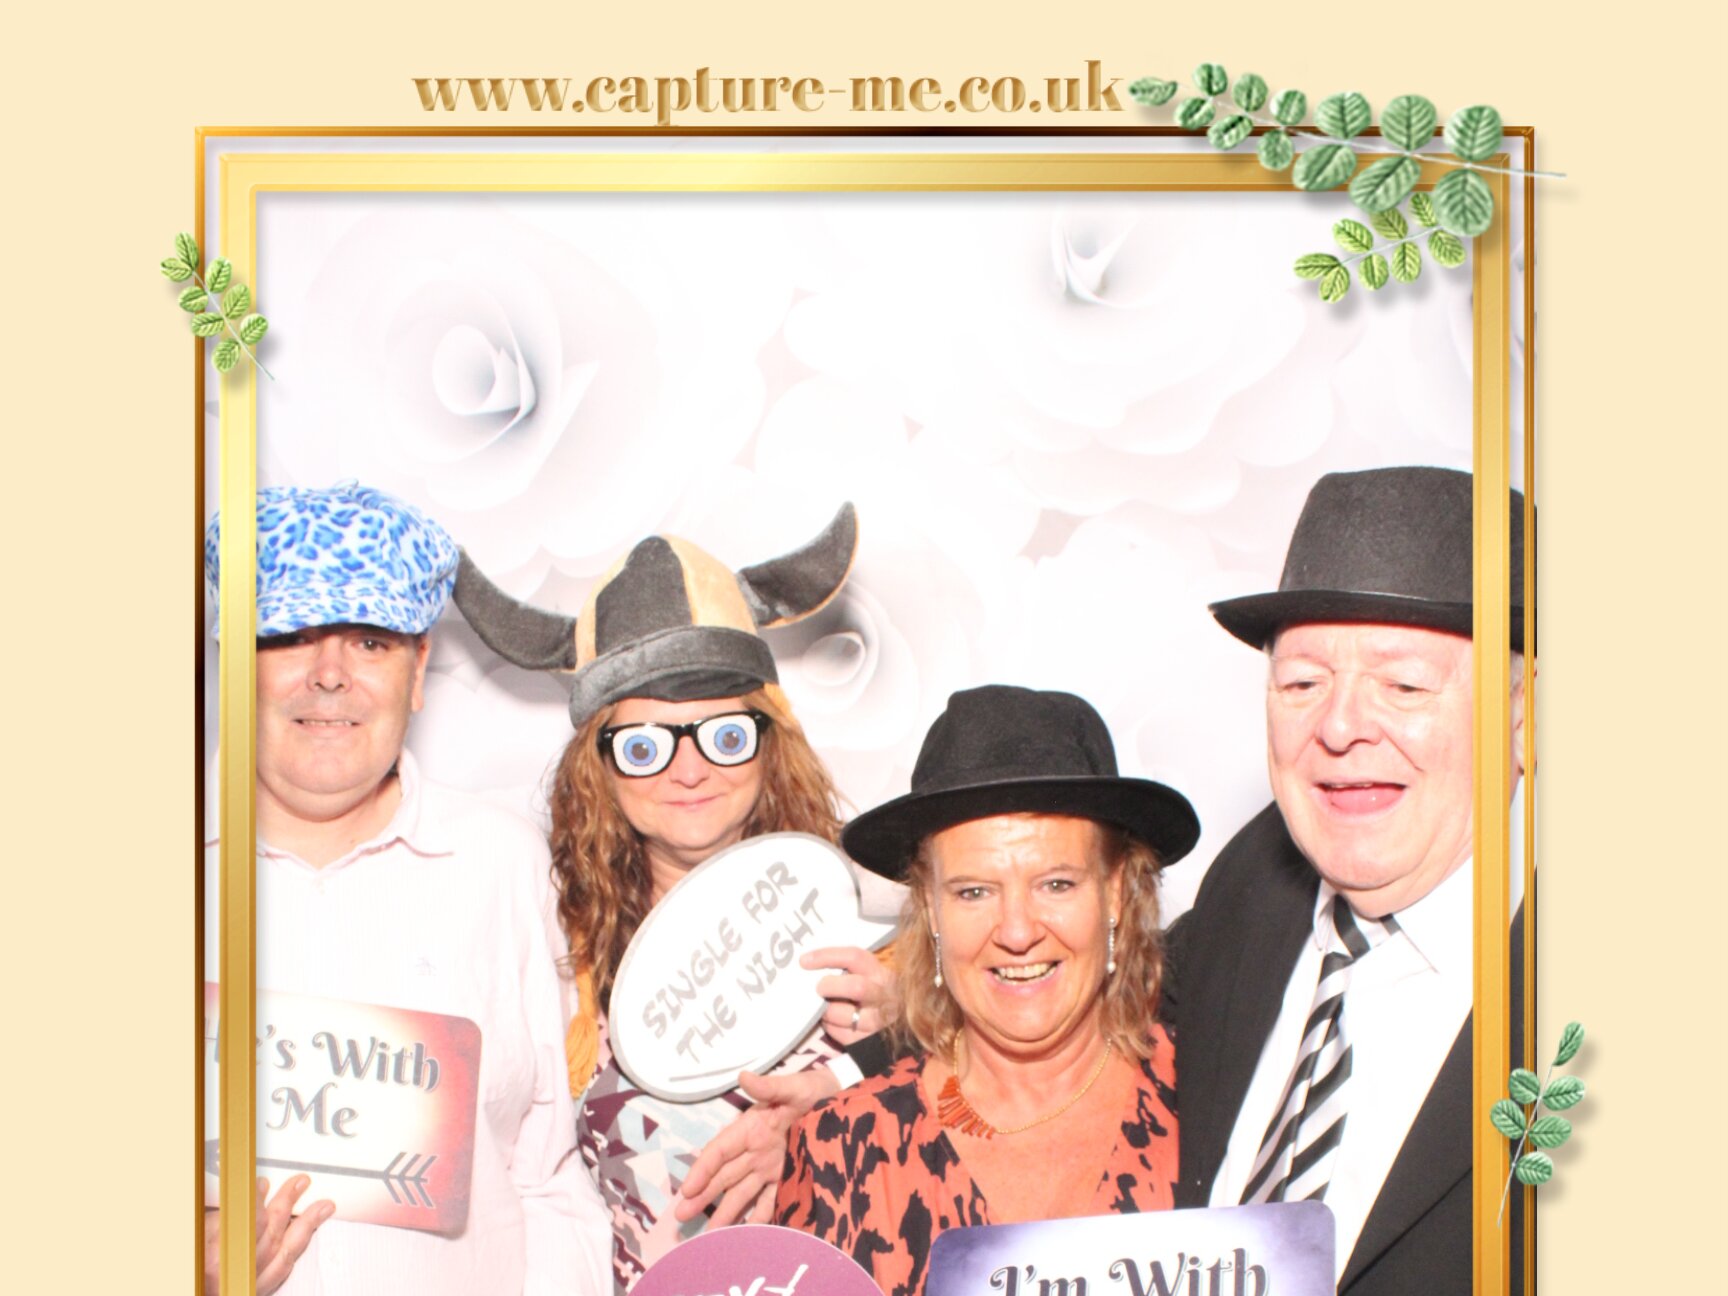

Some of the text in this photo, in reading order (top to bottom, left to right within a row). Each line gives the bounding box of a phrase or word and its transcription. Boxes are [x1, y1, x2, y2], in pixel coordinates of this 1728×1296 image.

[642, 861, 798, 1039] SINGLE FOR
[676, 888, 824, 1063] THE NIGHT
[266, 1082, 359, 1139] Me
[311, 1031, 441, 1091] With
